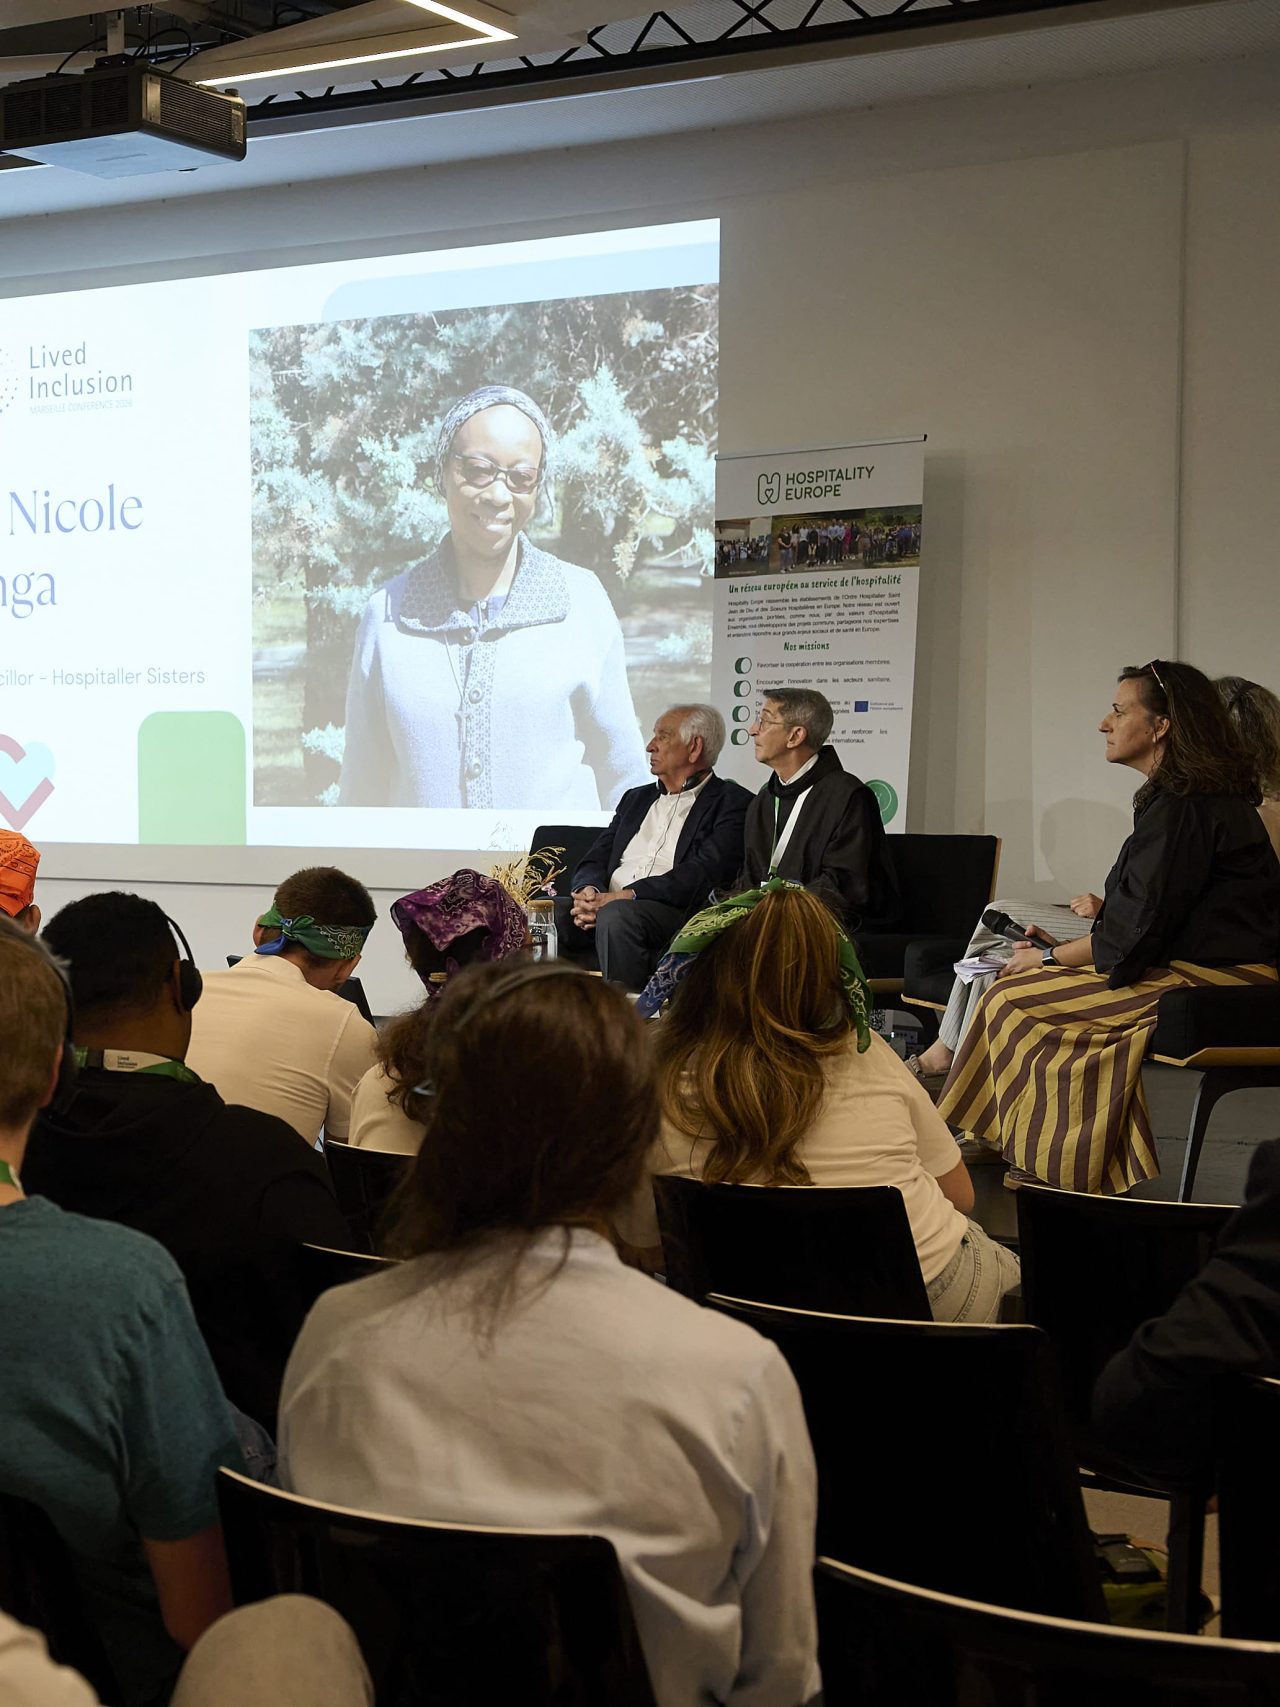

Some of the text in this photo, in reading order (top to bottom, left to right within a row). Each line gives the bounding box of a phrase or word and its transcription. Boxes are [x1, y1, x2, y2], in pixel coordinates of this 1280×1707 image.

[30, 341, 86, 369] Lived
[30, 370, 132, 399] Inclusion
[67, 400, 113, 412] CONFERENCE
[786, 465, 875, 485] HOSPITALITY
[785, 484, 841, 500] EUROPE
[9, 483, 144, 536] Nicole
[729, 583, 738, 593] Un
[741, 582, 761, 592] réseau
[764, 580, 798, 593] européen
[812, 578, 837, 589] service
[840, 578, 848, 587] de
[851, 575, 901, 588] l'hospitalité
[784, 642, 829, 651] Nos missions
[53, 668, 141, 690] Hospitaller
[147, 666, 206, 685] Sisters
